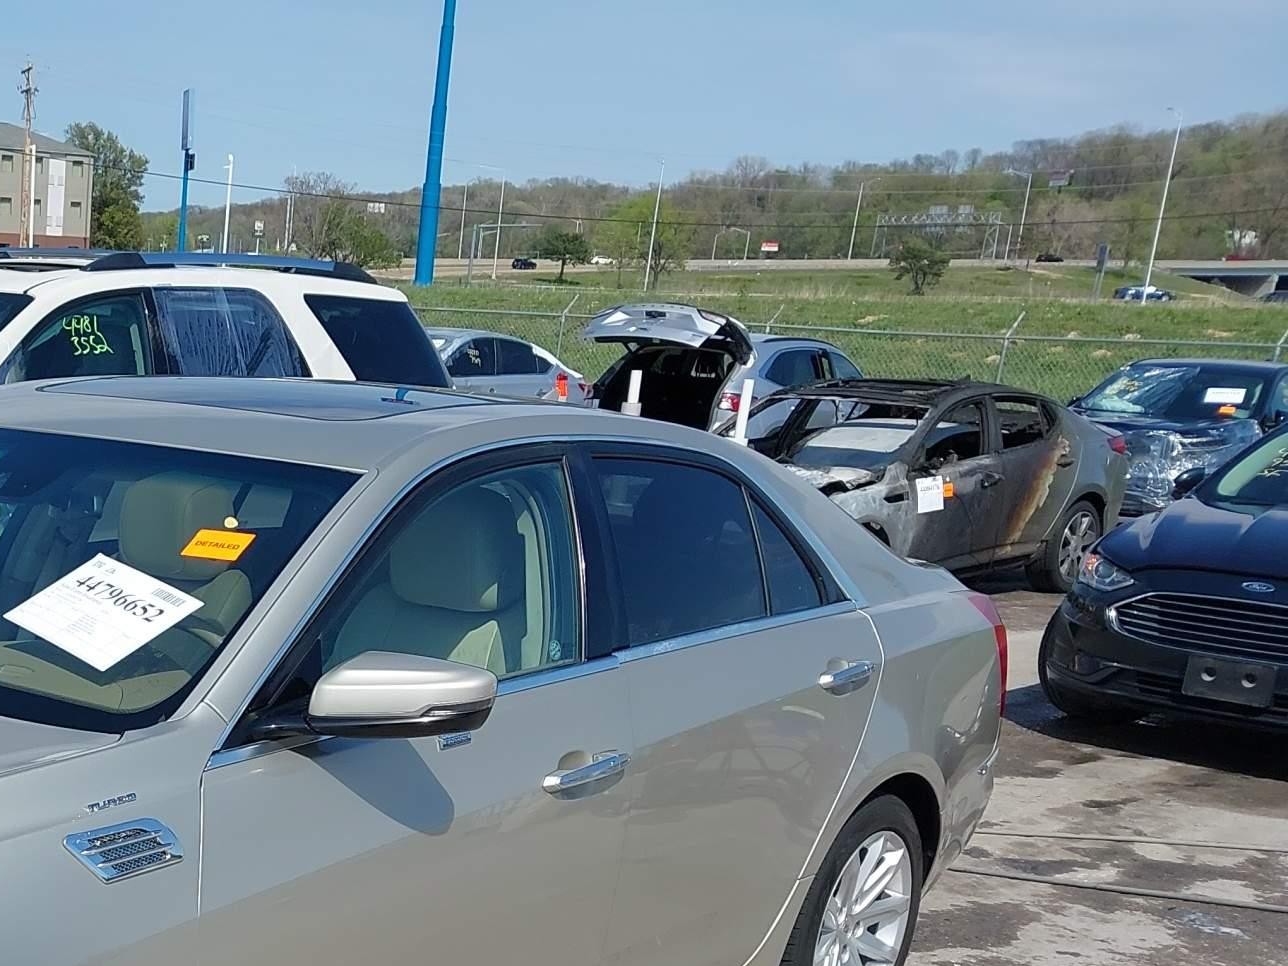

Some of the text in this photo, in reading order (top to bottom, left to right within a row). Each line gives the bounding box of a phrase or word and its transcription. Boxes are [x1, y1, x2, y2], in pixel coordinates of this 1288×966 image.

[62, 314, 98, 337] 4481
[194, 539, 242, 551] DETAILED
[75, 574, 166, 623] 44796652
[87, 791, 137, 813] TURBO
